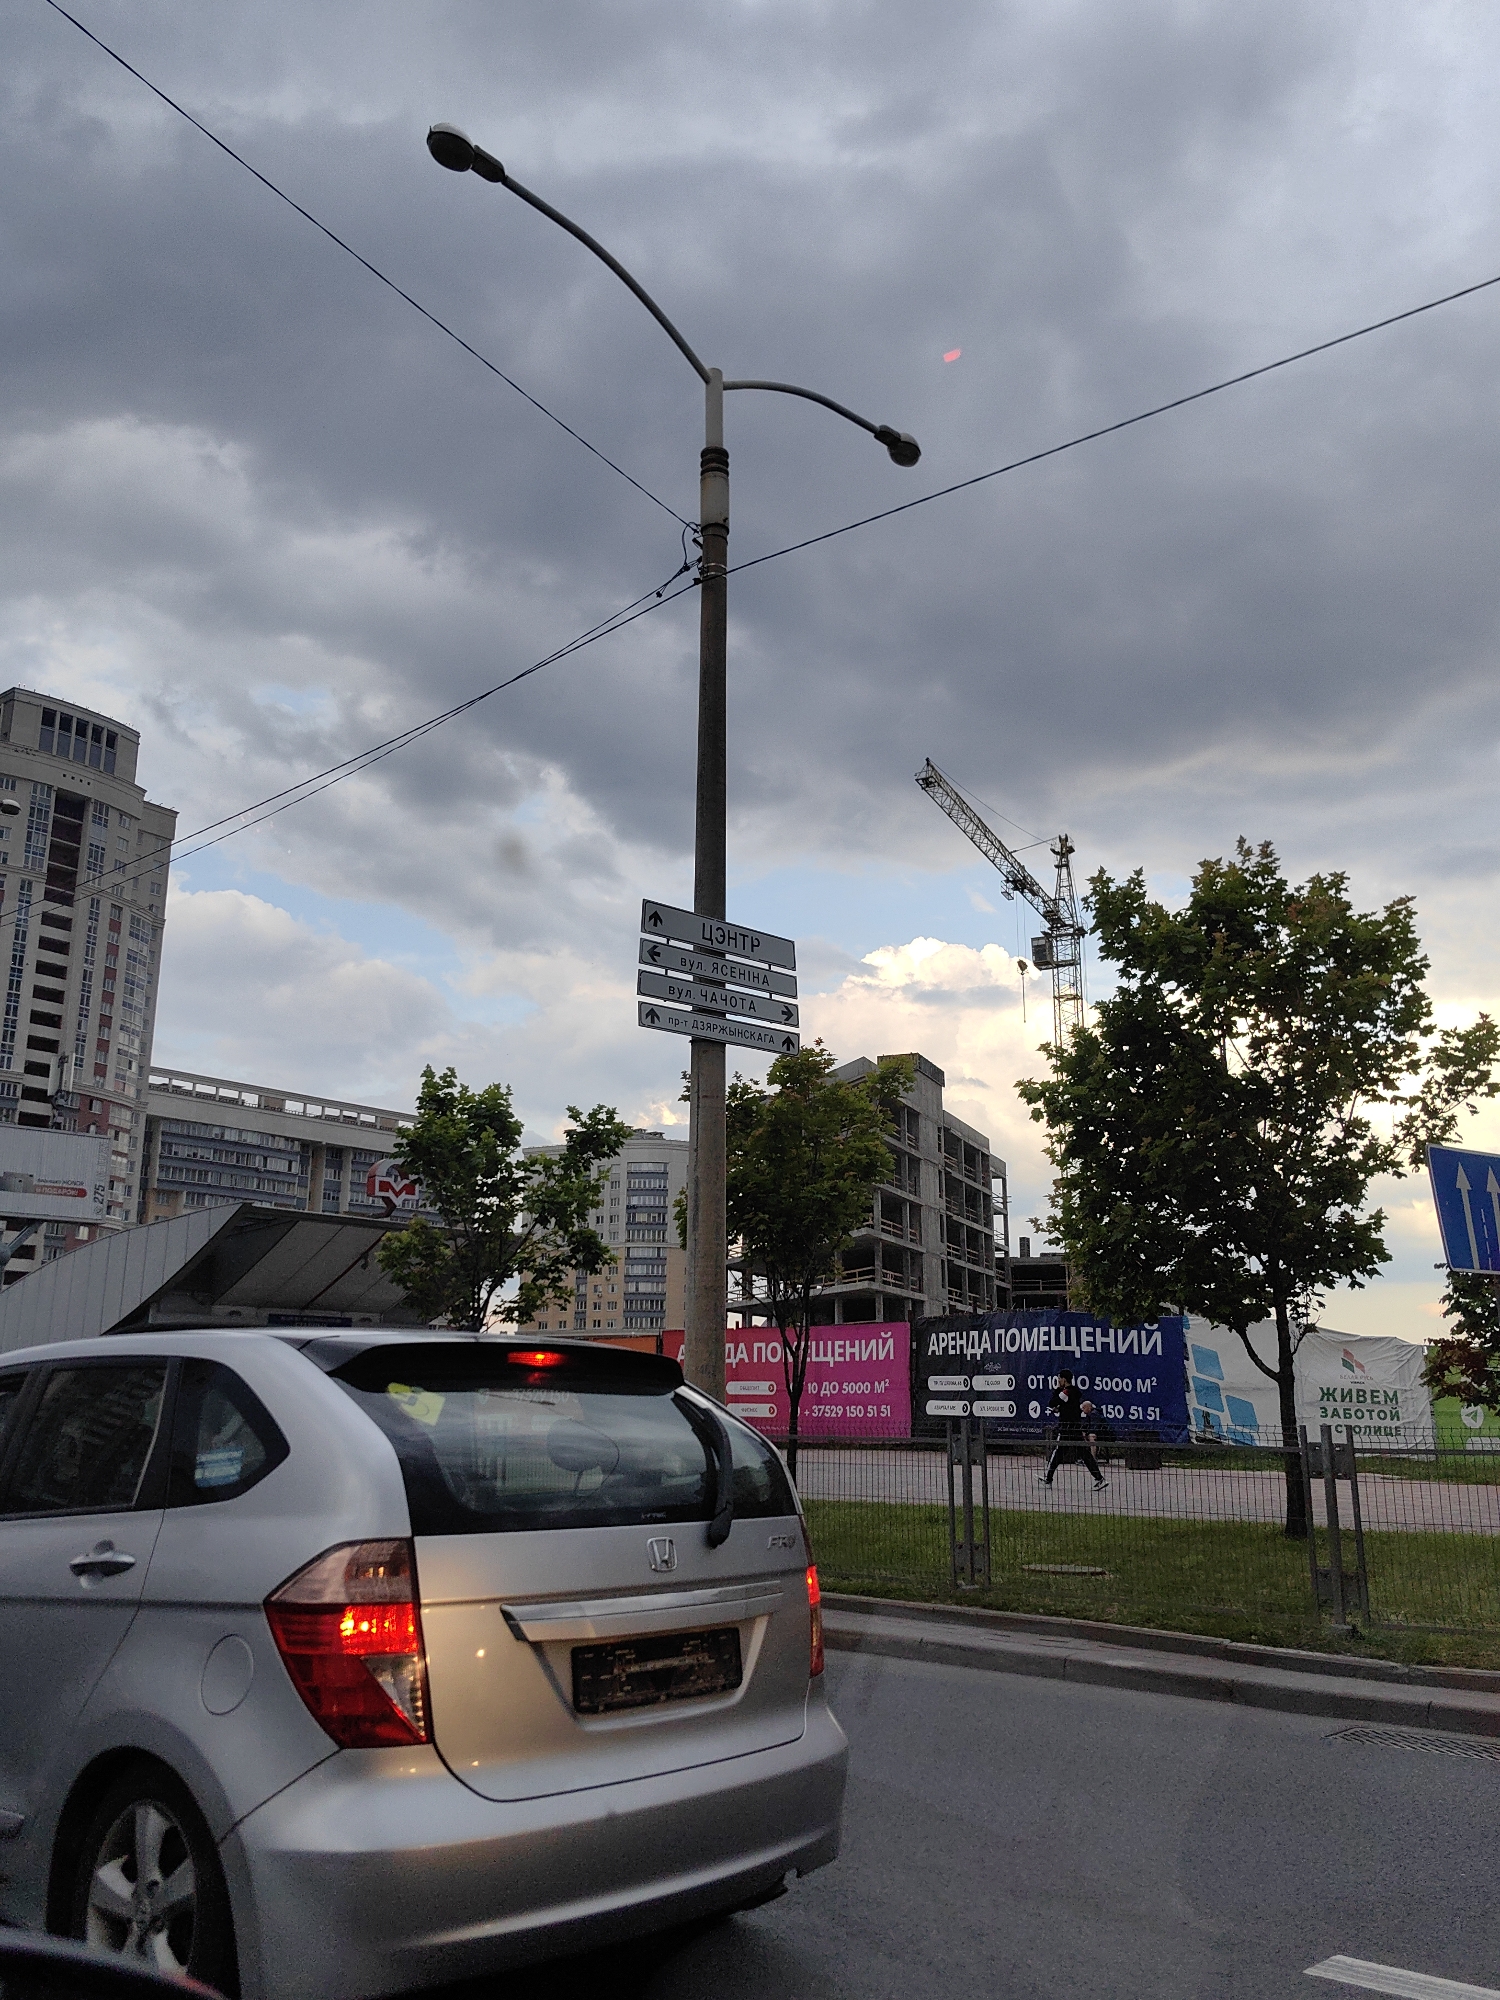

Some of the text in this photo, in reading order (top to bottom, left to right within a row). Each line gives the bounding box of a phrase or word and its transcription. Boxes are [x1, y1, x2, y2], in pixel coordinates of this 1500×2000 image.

[701, 922, 760, 953] ЦЭНТР
[680, 957, 770, 987] вул. ЯСЕНІНА
[668, 985, 757, 1013] вул. ЧАЧОТА
[668, 1015, 775, 1045] пр-т ДЗЯРЖЫНСКАГА
[927, 1323, 1163, 1360] АРЕНДА ПОМЕЩЕНИЙ
[807, 1382, 817, 1395] 10
[820, 1382, 839, 1398] ДО
[841, 1381, 871, 1395] 5000
[1027, 1375, 1044, 1390] ОТ
[1048, 1375, 1060, 1390] 10
[1093, 1376, 1132, 1393] 5000
[1318, 1386, 1399, 1405] ЖИВЕМ
[846, 1405, 864, 1418] 150
[866, 1405, 878, 1418] 51
[880, 1404, 891, 1417] 51
[1100, 1405, 1160, 1421] 150 51 51
[1319, 1406, 1400, 1422] ЗАБОТОЙ
